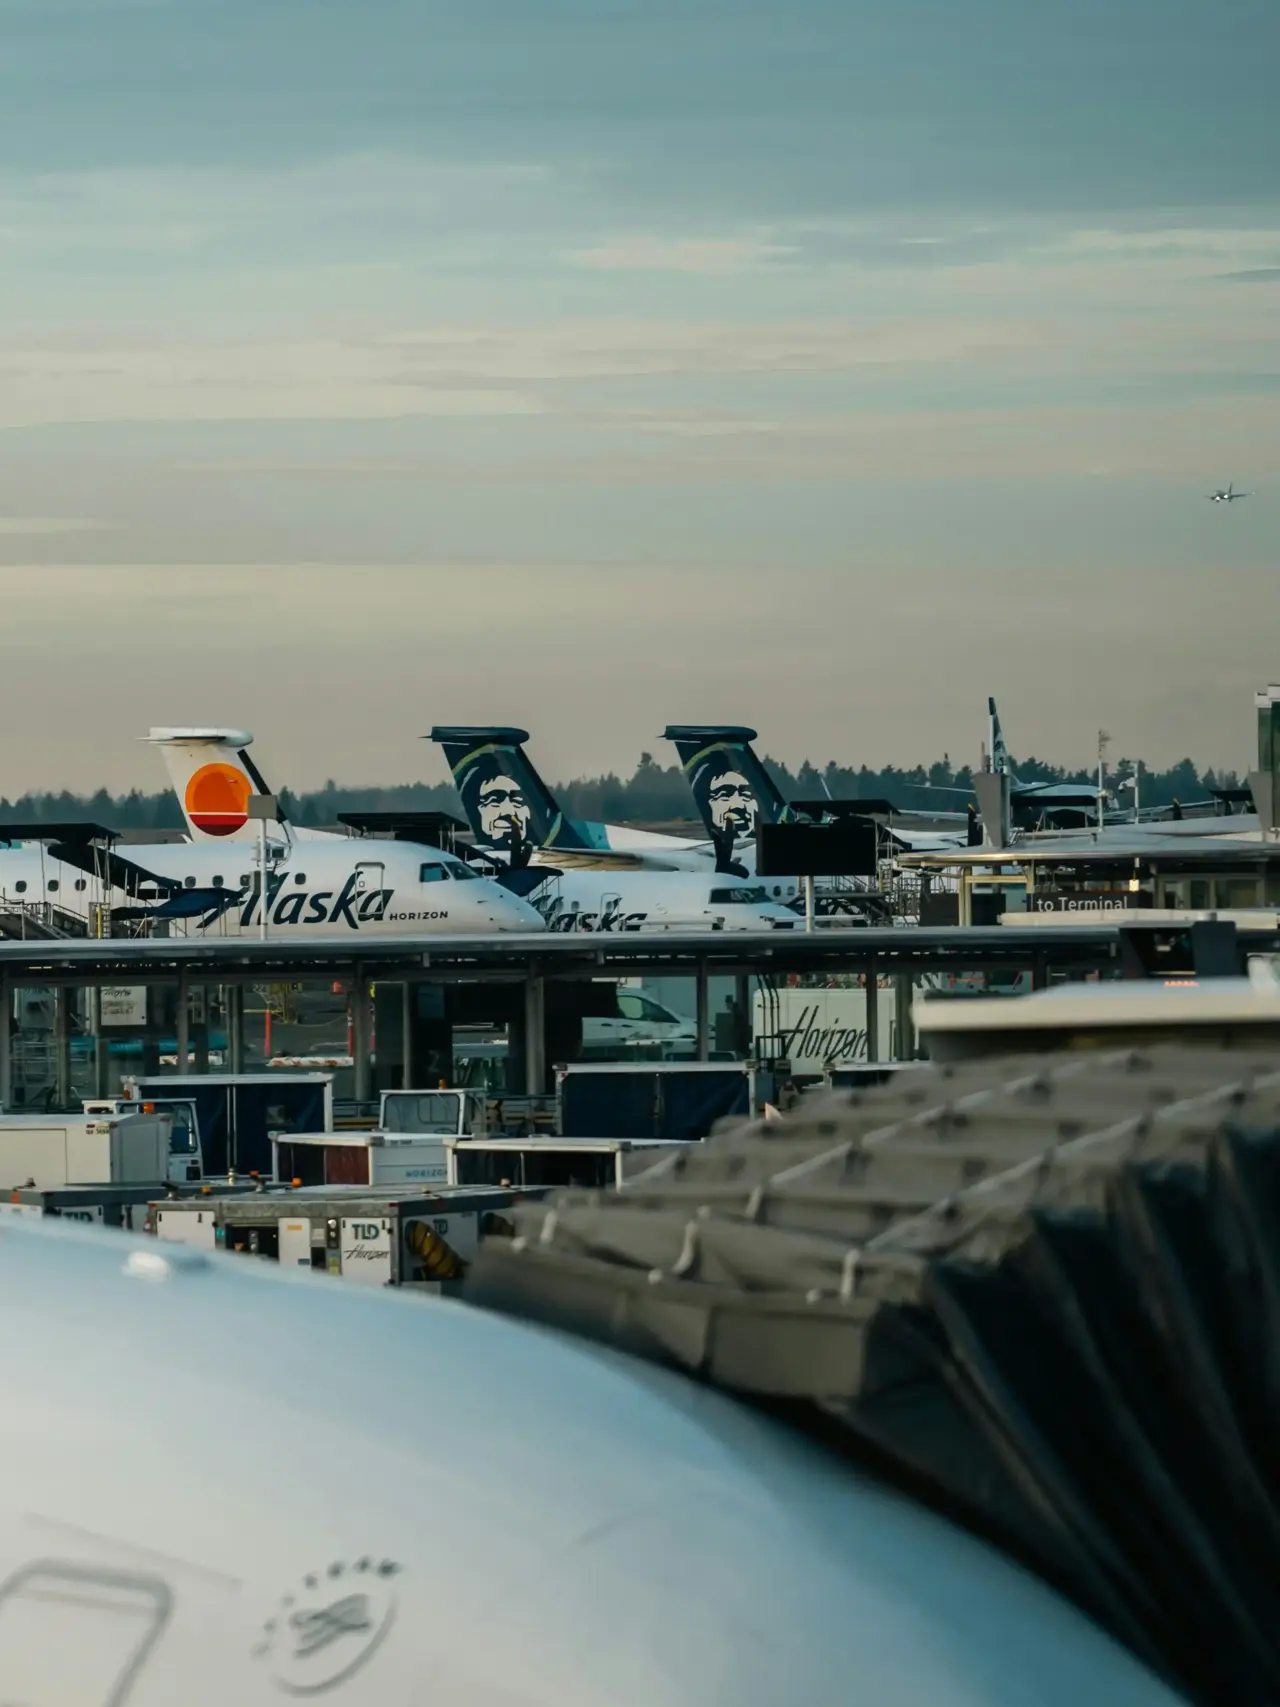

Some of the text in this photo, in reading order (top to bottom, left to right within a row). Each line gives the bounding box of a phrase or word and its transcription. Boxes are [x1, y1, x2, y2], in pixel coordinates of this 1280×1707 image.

[1037, 896, 1128, 912] to Terminal
[389, 911, 449, 921] HORIZON
[352, 1224, 380, 1240] TLD
